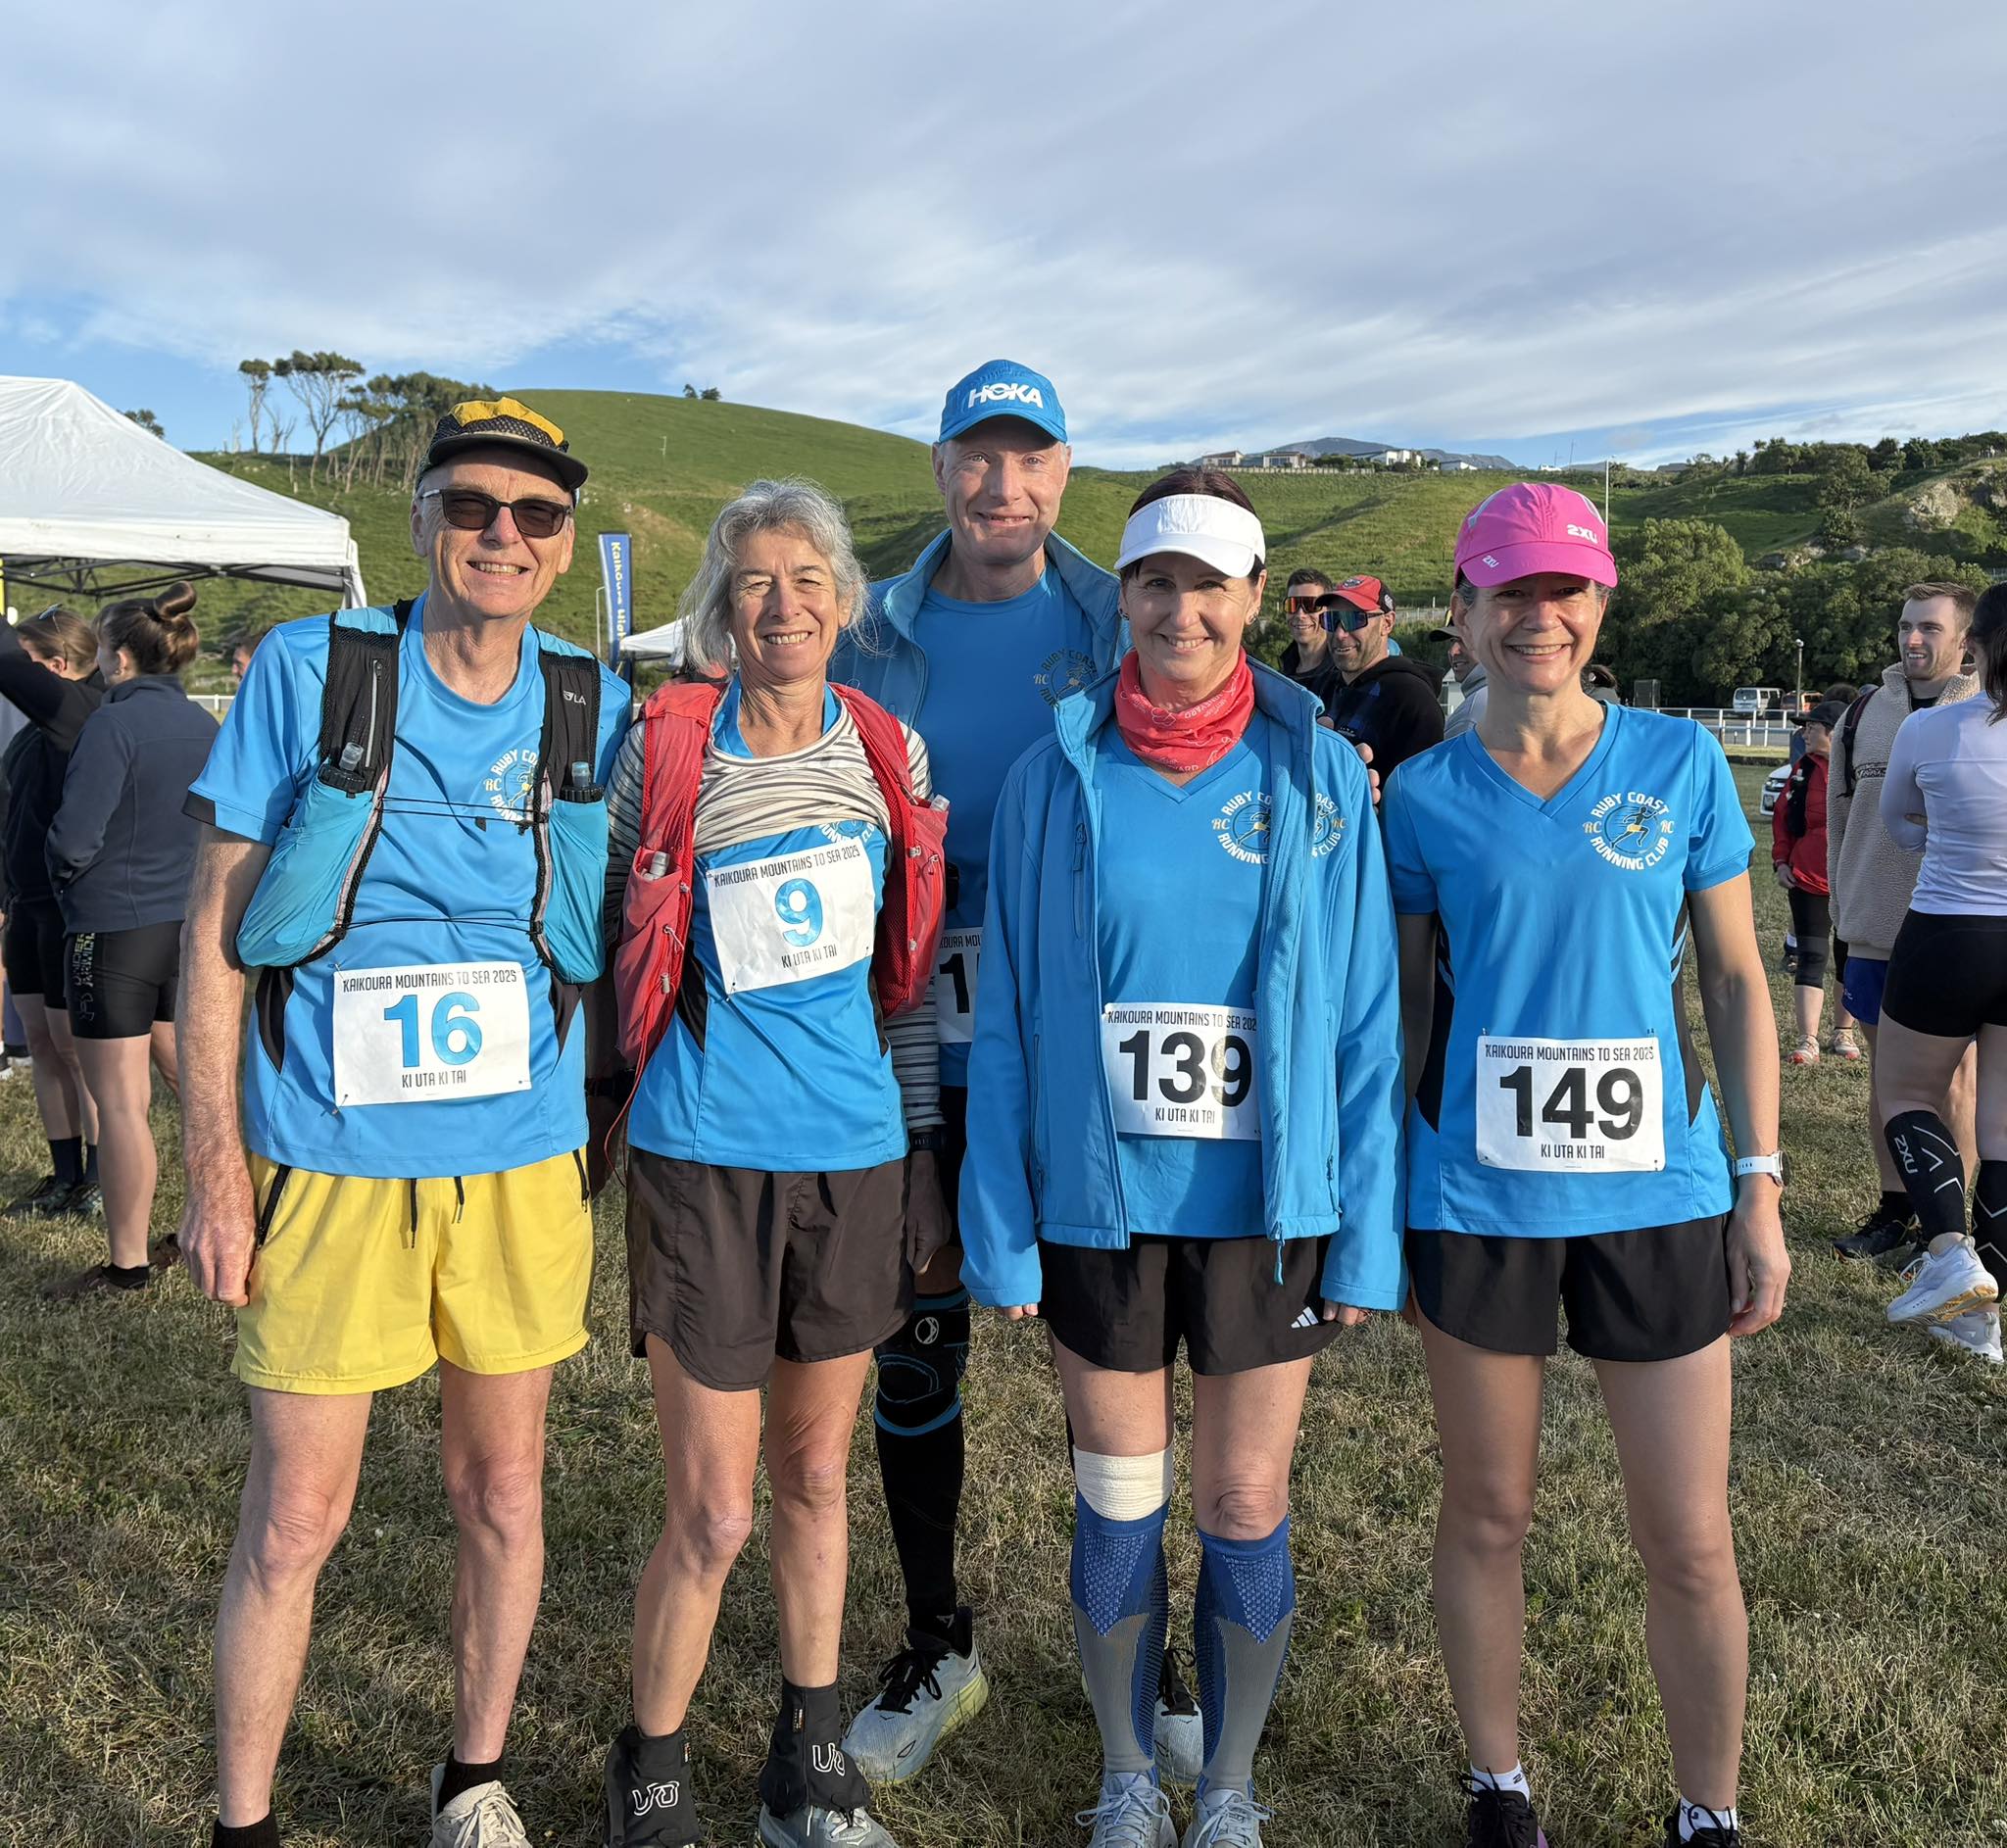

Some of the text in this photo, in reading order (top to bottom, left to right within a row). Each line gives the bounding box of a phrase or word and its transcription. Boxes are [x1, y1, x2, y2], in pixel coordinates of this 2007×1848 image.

[967, 382, 1044, 409] HOKA
[1566, 523, 1598, 544] 2XU
[611, 541, 623, 605] Kaikoura
[1482, 555, 1499, 568] 2XU
[490, 749, 518, 777] RUBY
[483, 778, 503, 792] RC
[1221, 791, 1252, 816] RUBY
[1591, 792, 1670, 818] RUBY COAST
[1211, 818, 1231, 831] RC
[1582, 821, 1602, 833] RC
[1660, 820, 1675, 833] RC
[1318, 832, 1342, 855] CLUB
[1590, 836, 1669, 870] RUNNING CLUB
[713, 867, 759, 888] KAIKOURA
[759, 855, 812, 879] MOUNTAINS
[813, 852, 826, 867] TO
[826, 850, 842, 864] SEA
[774, 877, 823, 948] 9
[781, 944, 837, 968] KI UTA KI TAI
[343, 969, 517, 993] KAIKOURA MOUNTAINS TO SEA 2025
[939, 952, 980, 1014] 1
[383, 992, 482, 1068] 16
[1107, 1010, 1152, 1025] KAIKOURA
[1155, 1011, 1209, 1027] MOUNTAINS
[1211, 1013, 1223, 1027] TO
[1226, 1014, 1241, 1029] SEA
[1485, 1045, 1534, 1059] KAIKOURA
[1537, 1046, 1595, 1061] MOUNTAINS
[1597, 1046, 1610, 1061] TO
[1613, 1047, 1631, 1061] SEA
[402, 1070, 466, 1088] KI UTA KI TAI
[1119, 1030, 1252, 1107] 139
[1499, 1065, 1643, 1141] 149
[1154, 1107, 1215, 1124] KI UTA KI TAI
[1541, 1144, 1605, 1159] KI UTA KI TAI
[1893, 1134, 1919, 1174] 2XU
